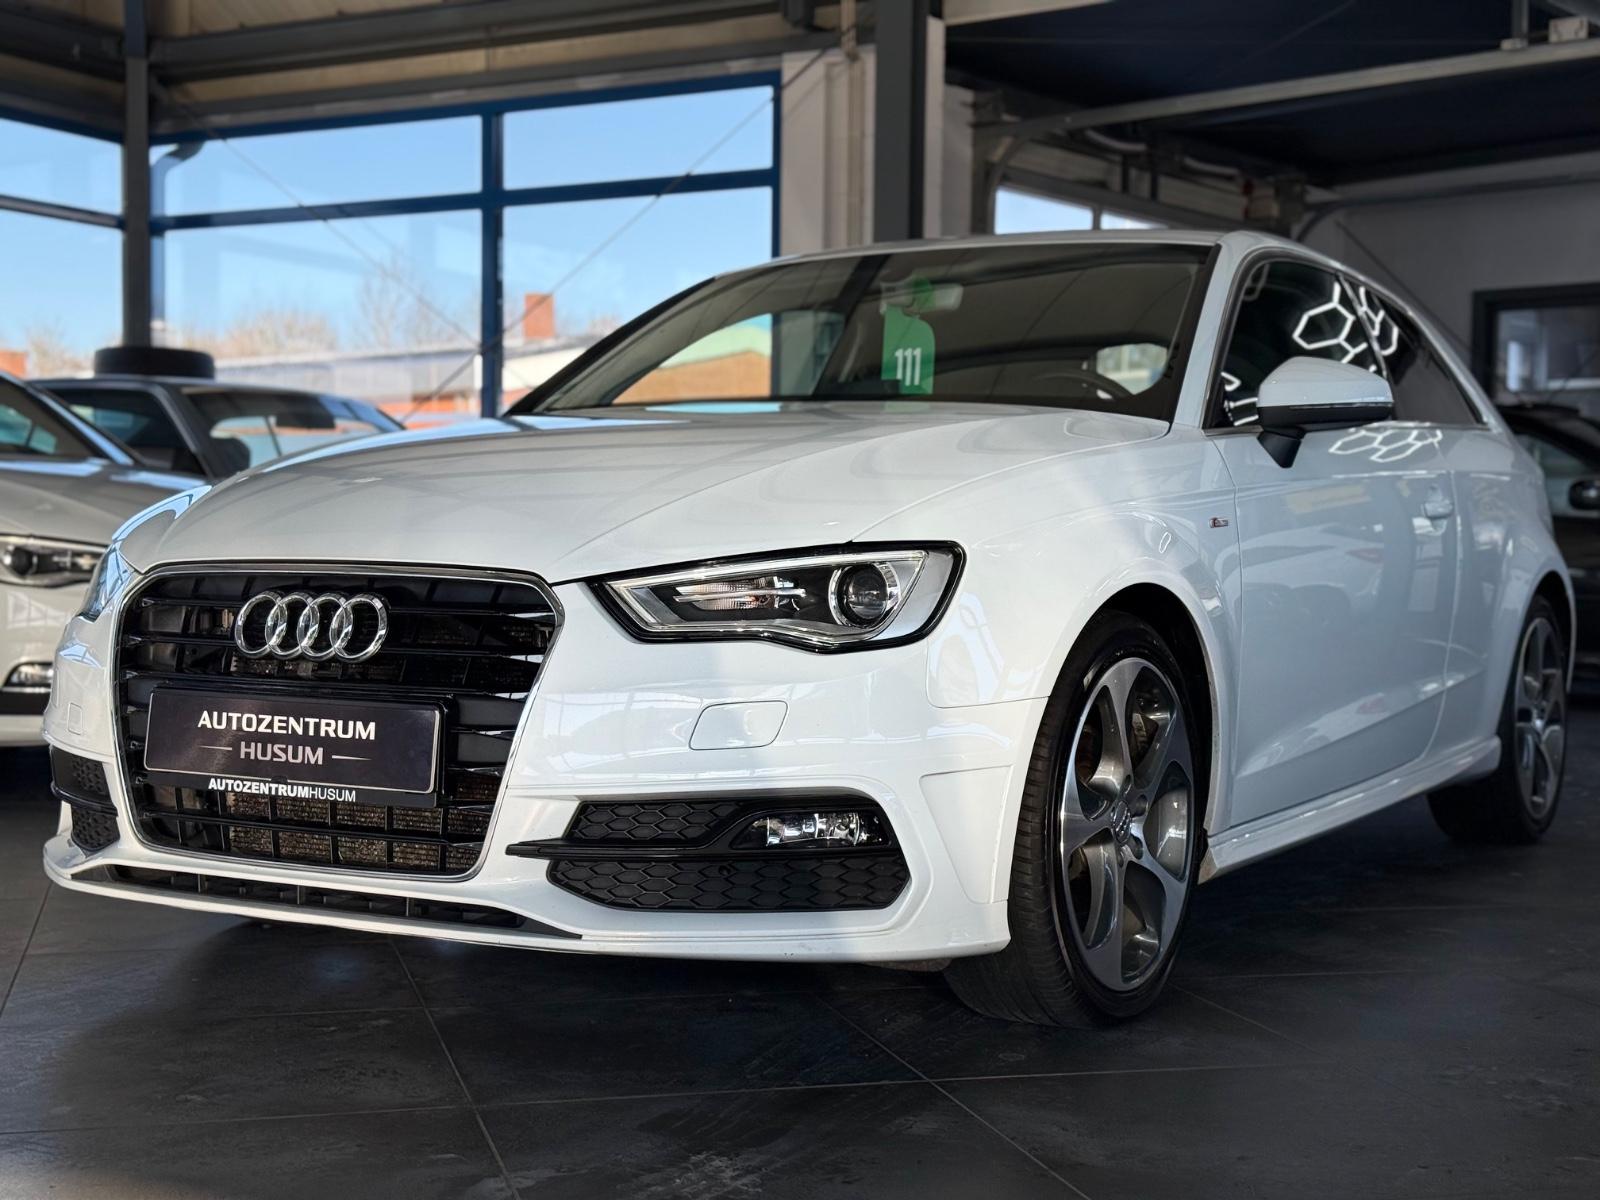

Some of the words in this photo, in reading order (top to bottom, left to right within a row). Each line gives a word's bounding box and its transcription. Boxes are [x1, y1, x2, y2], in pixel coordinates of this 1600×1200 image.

[894, 347, 922, 386] 111
[197, 710, 376, 741] AUTOZENTRUM
[240, 741, 324, 765] HUSUM
[208, 778, 356, 802] AUTOZENTRUMHUSUM
